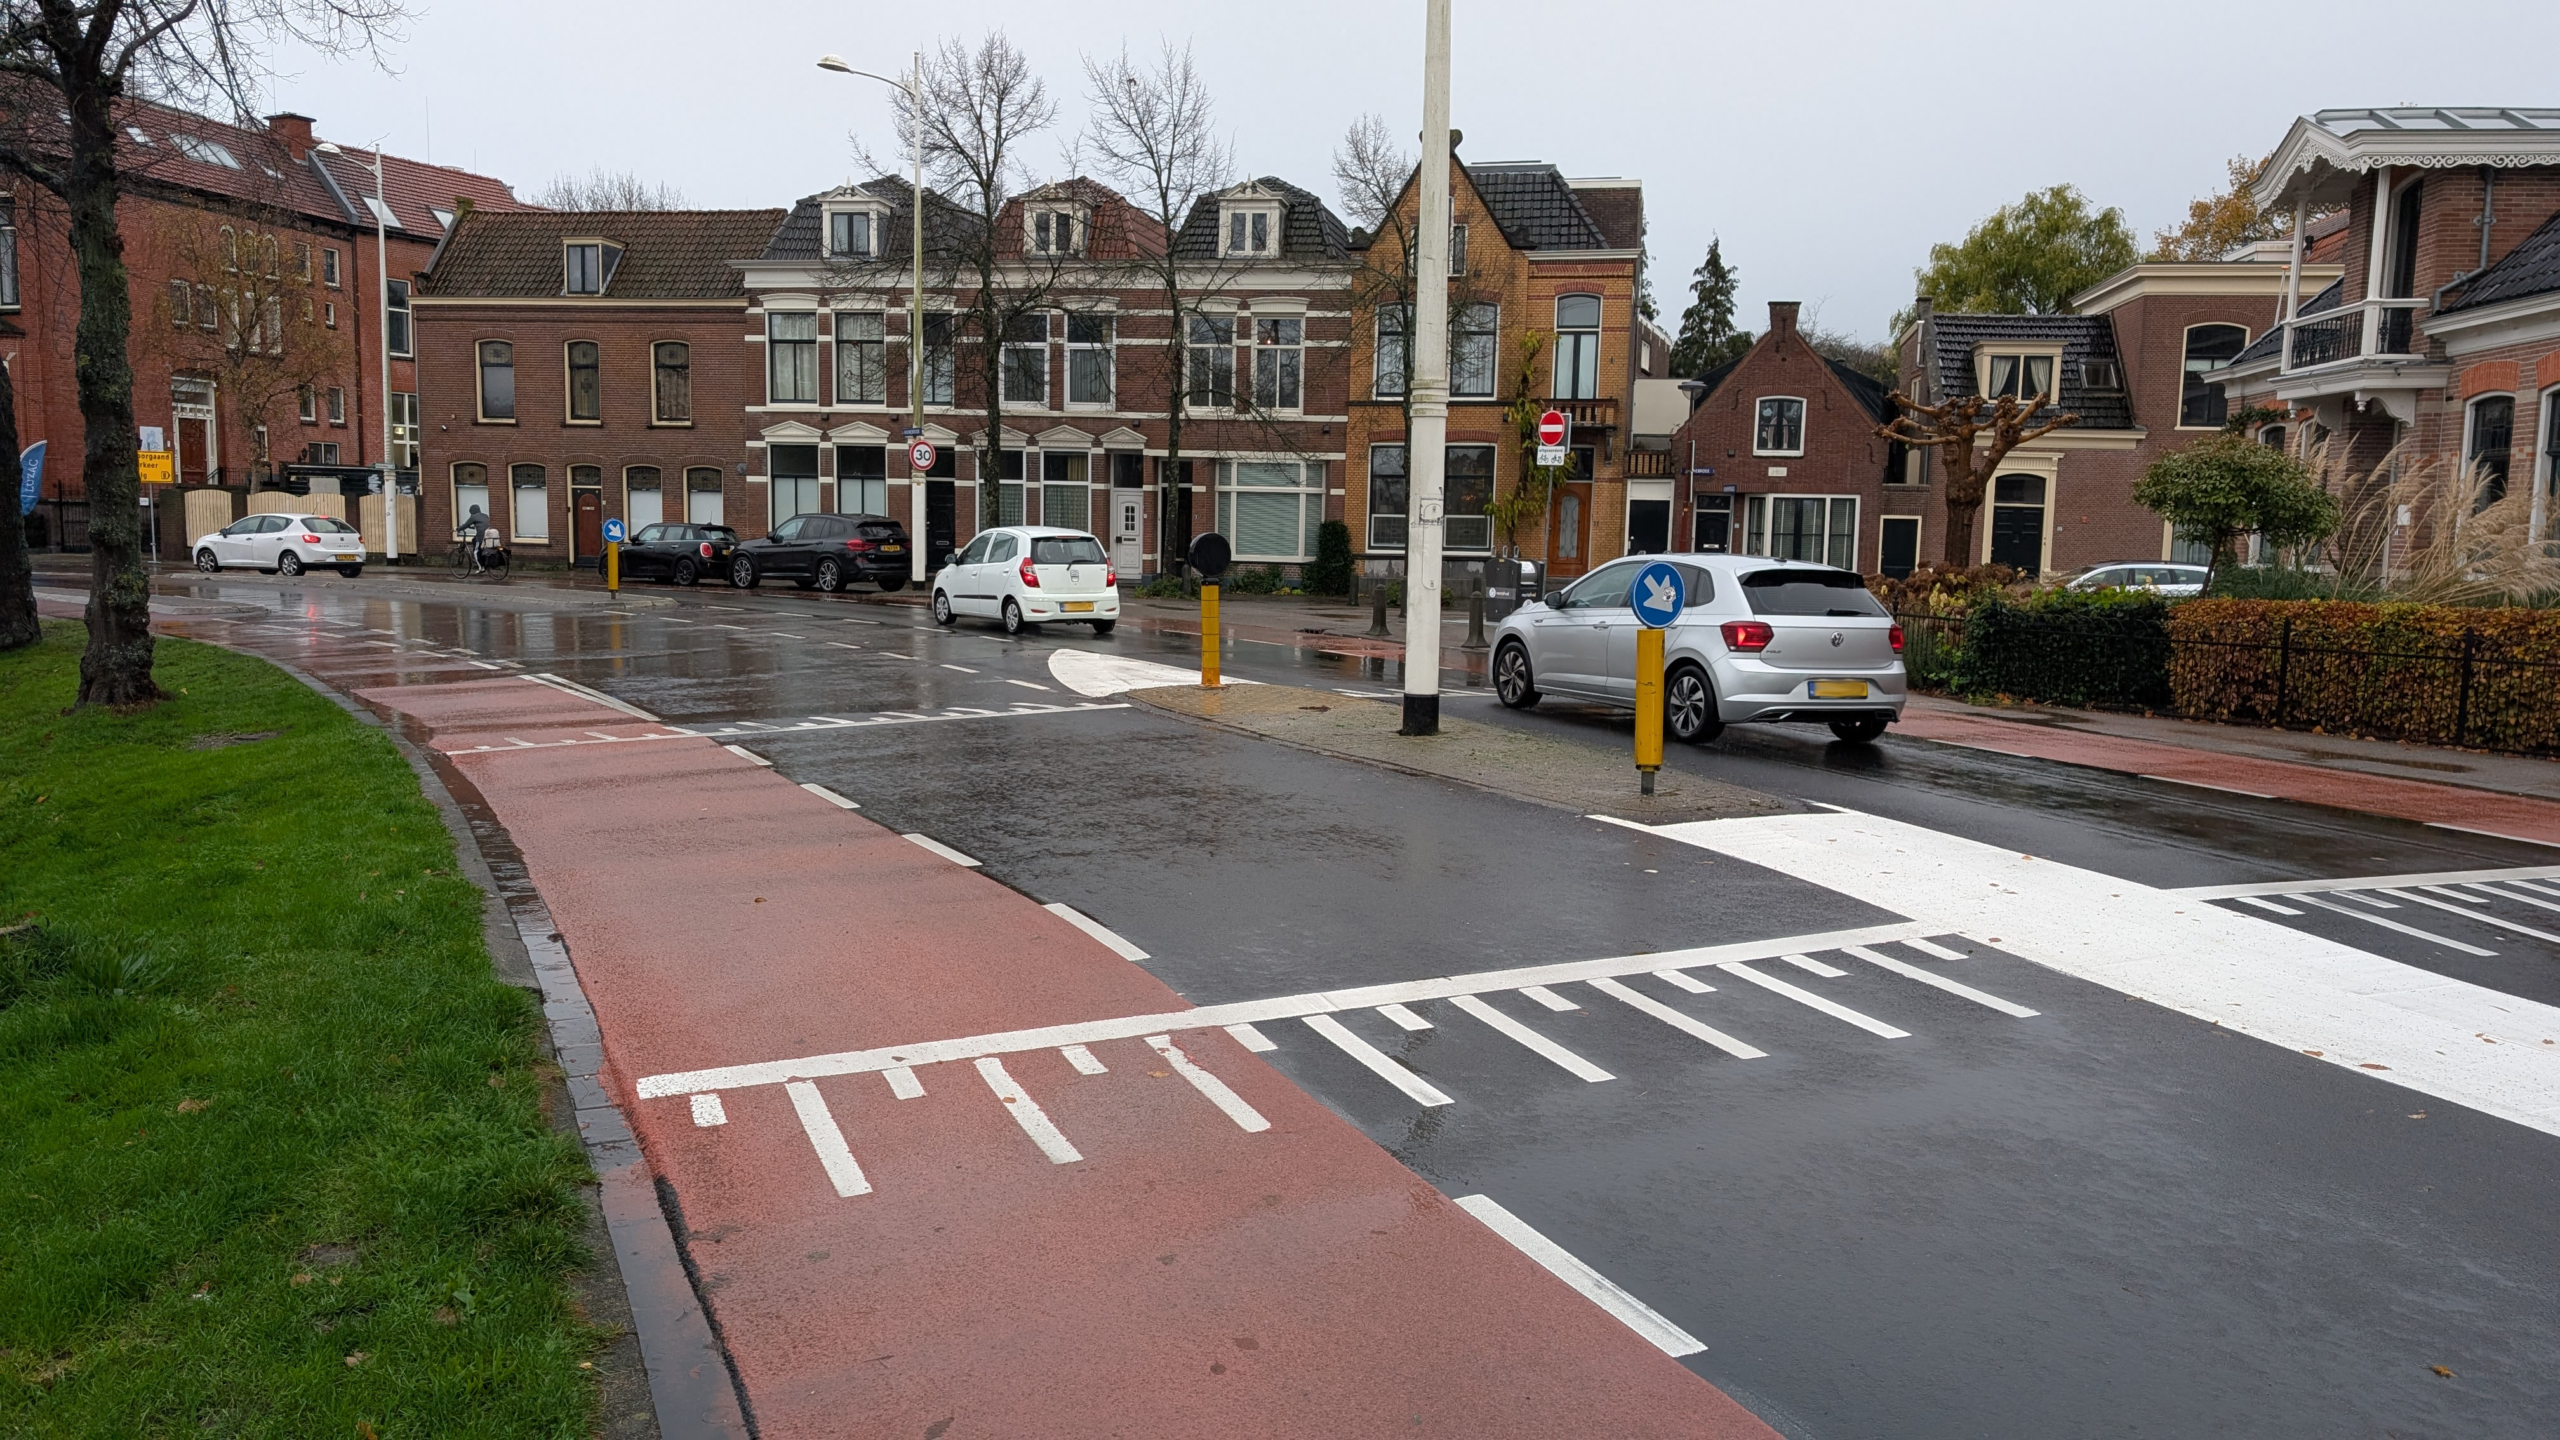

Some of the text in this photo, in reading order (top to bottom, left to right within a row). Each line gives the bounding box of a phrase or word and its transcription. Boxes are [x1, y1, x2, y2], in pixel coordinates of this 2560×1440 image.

[137, 453, 170, 461] oorgaand
[915, 449, 931, 462] 30
[139, 461, 159, 469] rkeer
[25, 459, 39, 493] LUZAC
[140, 472, 148, 480] lg
